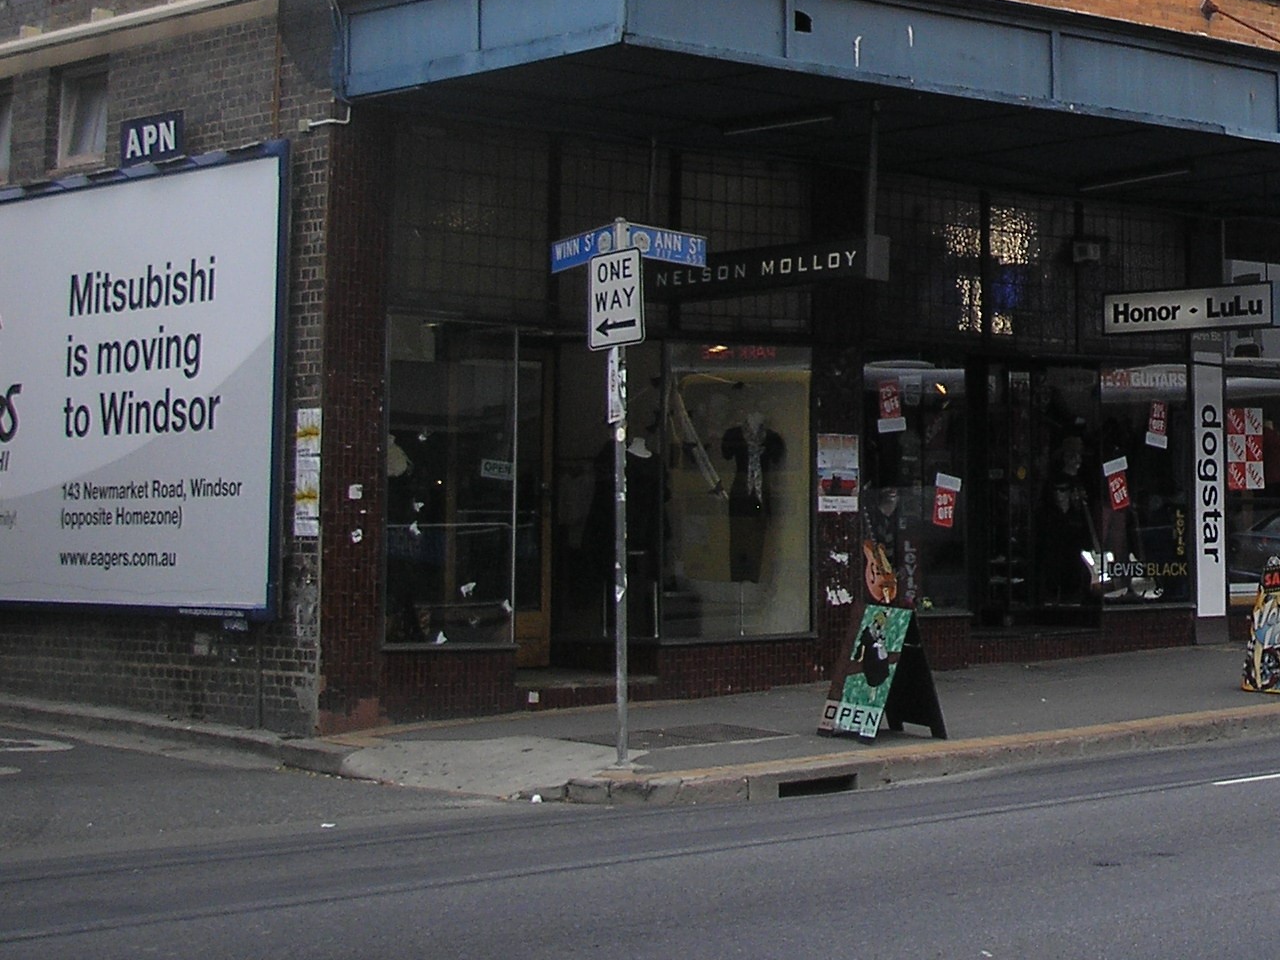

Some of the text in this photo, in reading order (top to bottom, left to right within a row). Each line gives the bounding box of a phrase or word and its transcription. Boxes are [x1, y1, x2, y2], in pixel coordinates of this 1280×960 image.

[125, 120, 176, 159] APN
[555, 239, 580, 262] WINN
[654, 231, 682, 252] ANN
[597, 257, 633, 284] ONE
[657, 250, 856, 287] NELSON MOLLOY
[69, 256, 216, 317] Mitsubishi
[595, 286, 635, 312] WAY
[1113, 295, 1263, 323] Honor LuLu
[66, 325, 201, 379] is moving
[63, 388, 221, 437] to Windsor
[1228, 408, 1244, 434] SALE
[1228, 435, 1262, 461] SALE SALE
[1197, 404, 1223, 563] dogstar
[1228, 462, 1263, 488] SALE SALE
[62, 477, 242, 501] 143 Newmarket Road, Windsor
[60, 506, 183, 529] (opposite Homezone)
[59, 550, 177, 571] www.eagers.com.au
[1146, 562, 1187, 577] BLACK
[824, 704, 879, 727] OPEN
